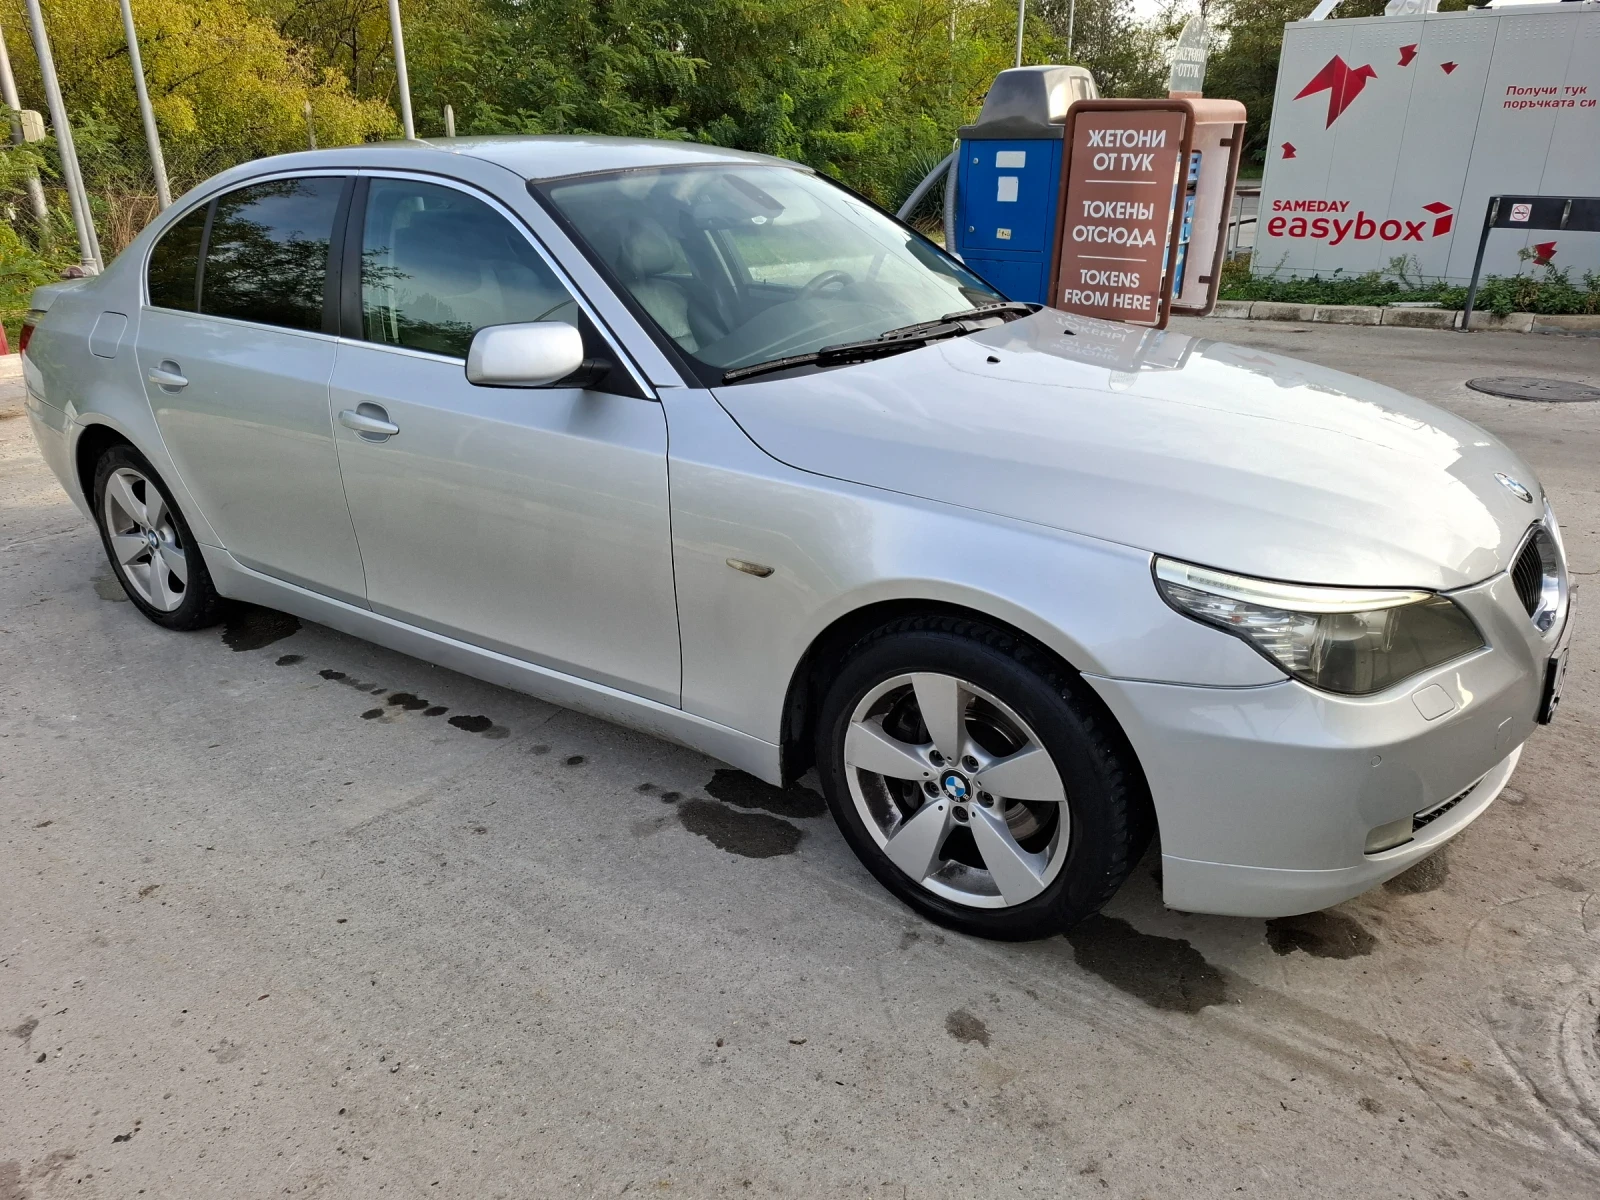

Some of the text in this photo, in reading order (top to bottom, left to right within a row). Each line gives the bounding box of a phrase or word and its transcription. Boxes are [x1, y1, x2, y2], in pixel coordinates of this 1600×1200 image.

[1506, 86, 1588, 97] Получи тук
[1503, 100, 1597, 110] поръчката си
[1087, 129, 1167, 148] ЖЕТОНИ
[1093, 153, 1155, 171] ОТ ТУК
[1082, 200, 1154, 220] ТОКЕНЫ
[1272, 200, 1350, 213] SAMEDAY
[1072, 225, 1156, 248] ОТСЮДА
[1267, 210, 1427, 246] easybox
[1080, 269, 1140, 288] TOKENS
[1064, 288, 1152, 310] FROM HERE
